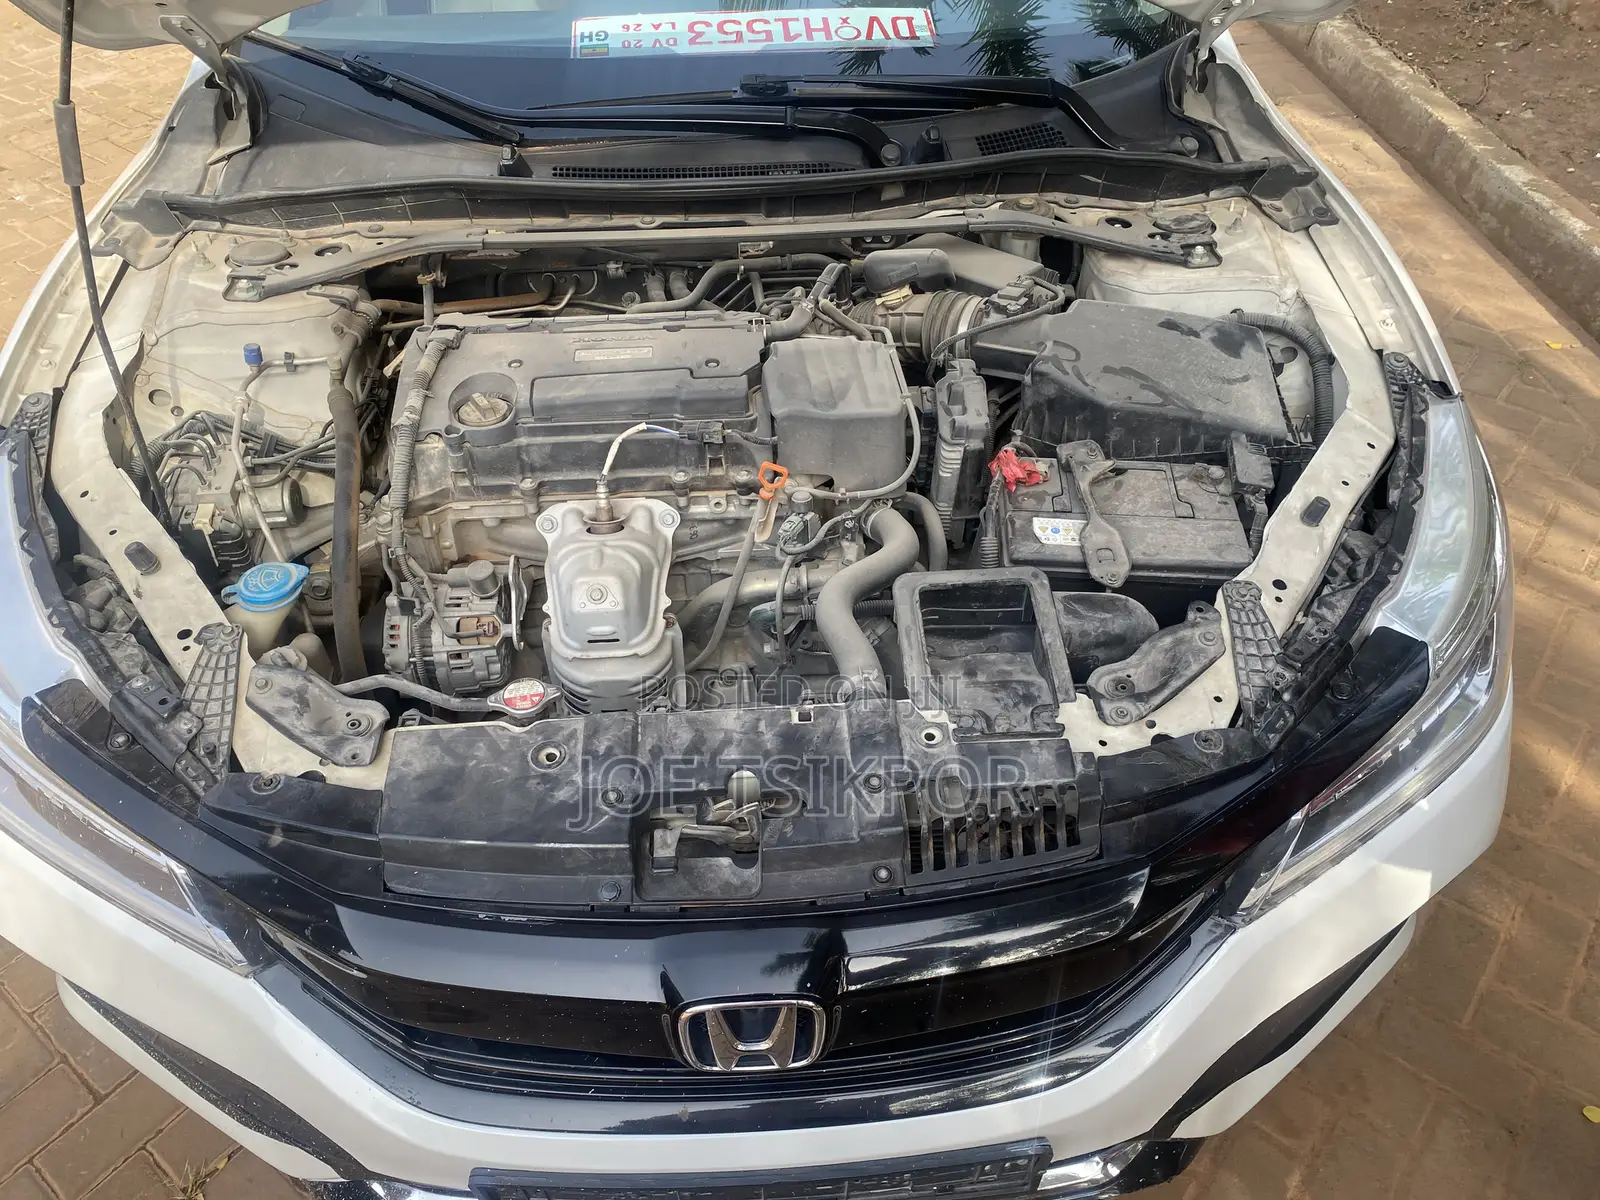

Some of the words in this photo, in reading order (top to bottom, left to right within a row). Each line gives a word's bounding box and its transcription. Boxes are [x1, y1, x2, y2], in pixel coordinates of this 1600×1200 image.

[621, 23, 643, 32] 26
[650, 21, 676, 31] LA
[688, 16, 834, 46] H1553
[866, 16, 920, 40] DV
[579, 30, 609, 43] GH
[621, 39, 643, 49] 20
[651, 37, 678, 48] DV
